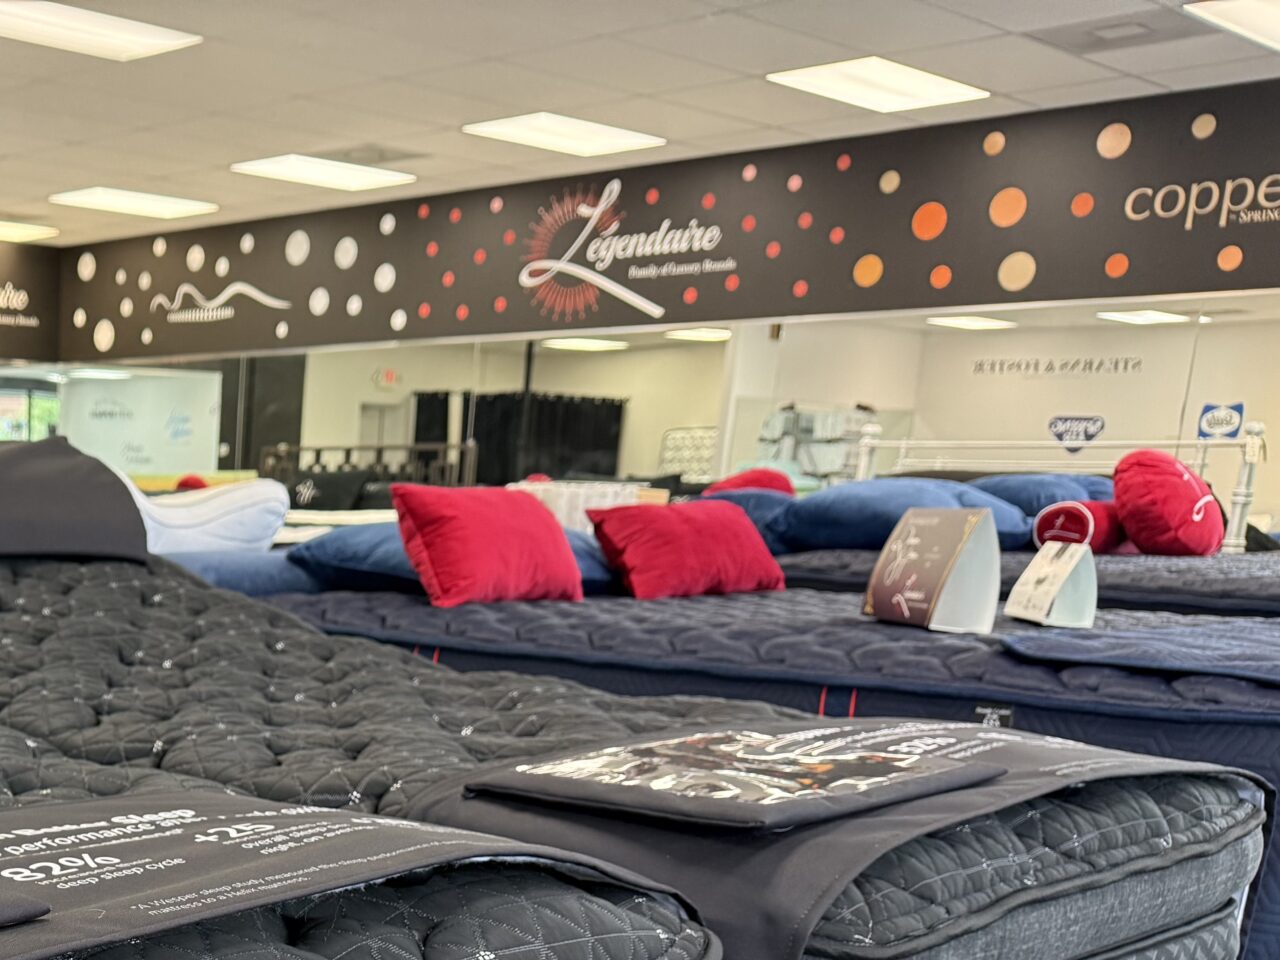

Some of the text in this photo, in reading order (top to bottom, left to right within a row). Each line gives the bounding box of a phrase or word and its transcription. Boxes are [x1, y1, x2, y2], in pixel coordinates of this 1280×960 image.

[3, 823, 156, 855] performance
[0, 853, 121, 881] 82%
[56, 876, 100, 889] deep
[100, 866, 144, 880] sleep
[145, 858, 186, 870] cycle
